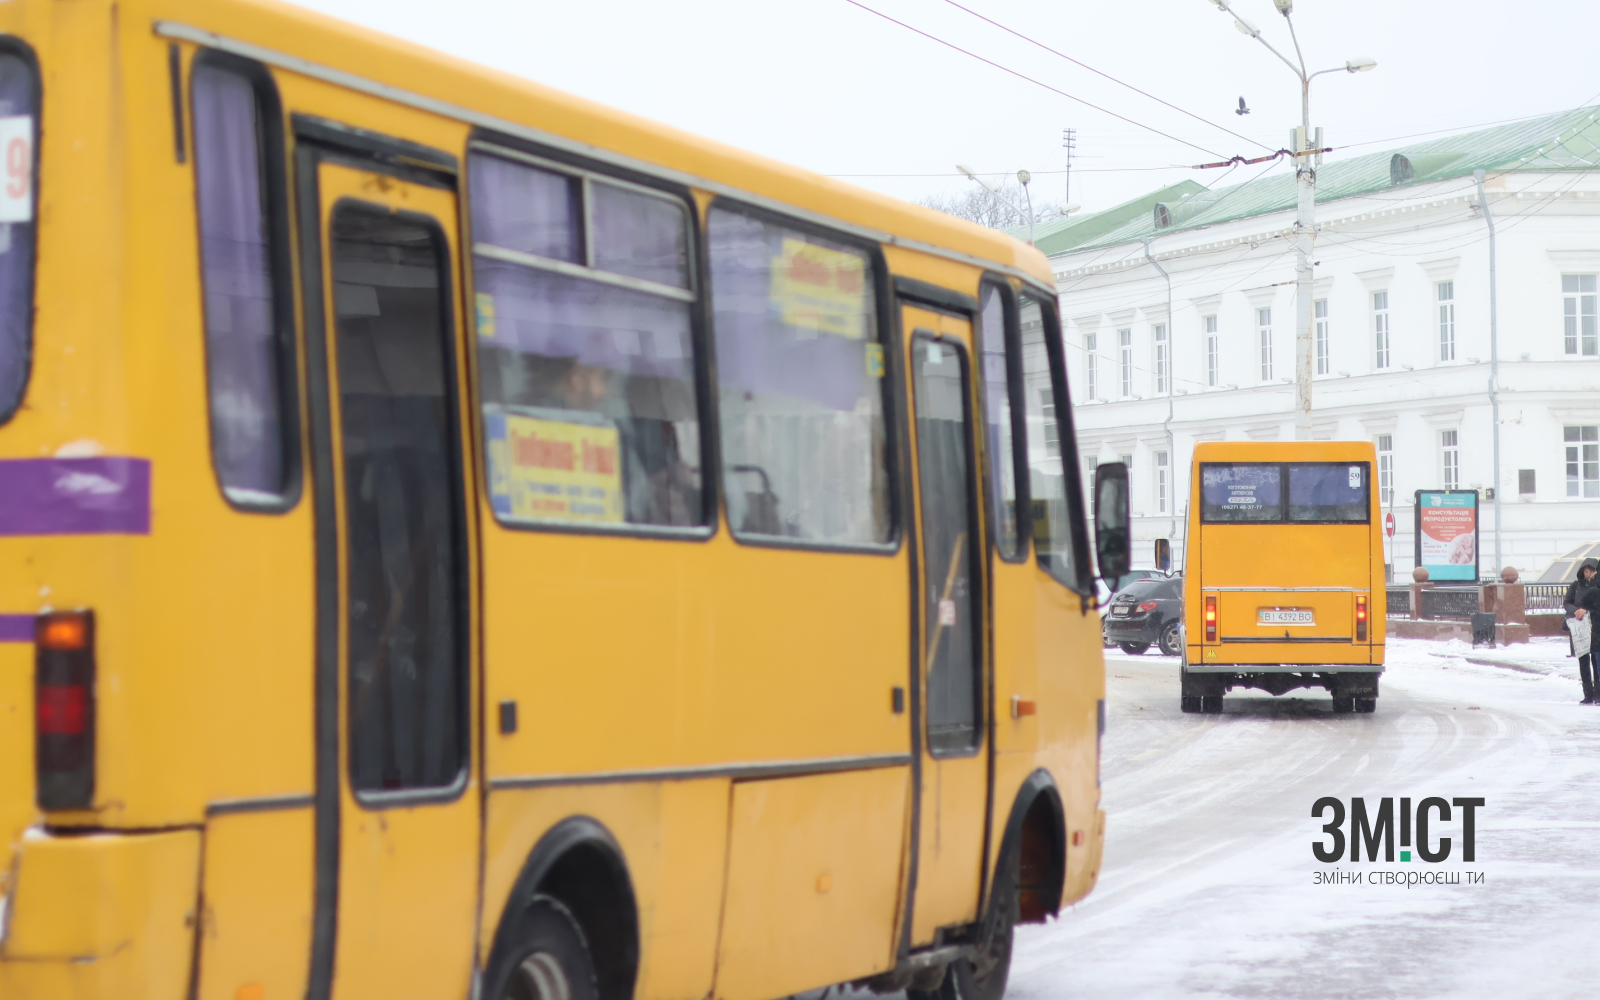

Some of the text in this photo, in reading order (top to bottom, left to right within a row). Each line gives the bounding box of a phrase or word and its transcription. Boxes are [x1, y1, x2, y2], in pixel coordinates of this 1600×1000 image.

[1350, 472, 1360, 481] 59
[1264, 612, 1275, 621] BI
[1278, 612, 1297, 621] 4392
